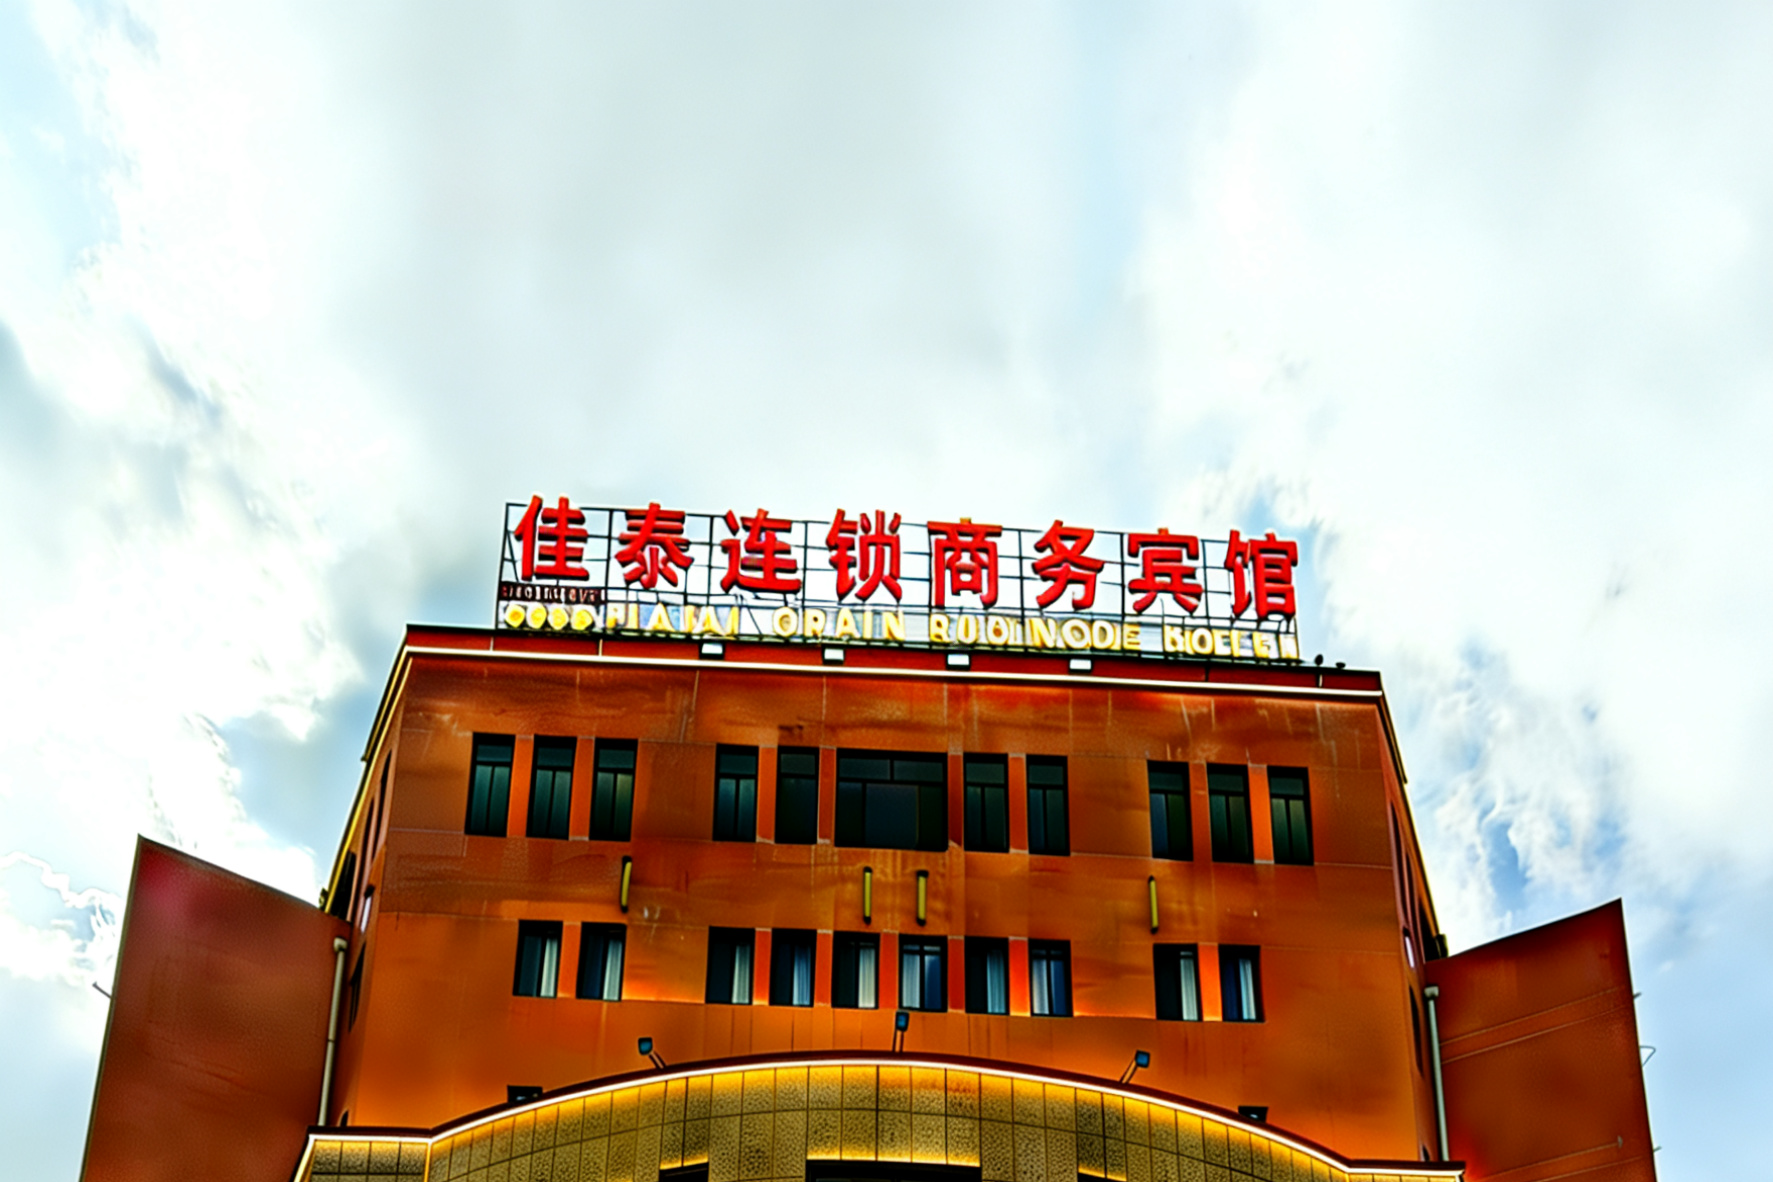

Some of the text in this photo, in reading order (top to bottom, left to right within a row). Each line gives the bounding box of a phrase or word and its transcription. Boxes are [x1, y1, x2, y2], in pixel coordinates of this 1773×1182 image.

[513, 494, 1299, 622] 佳泰连锁商务宾馆
